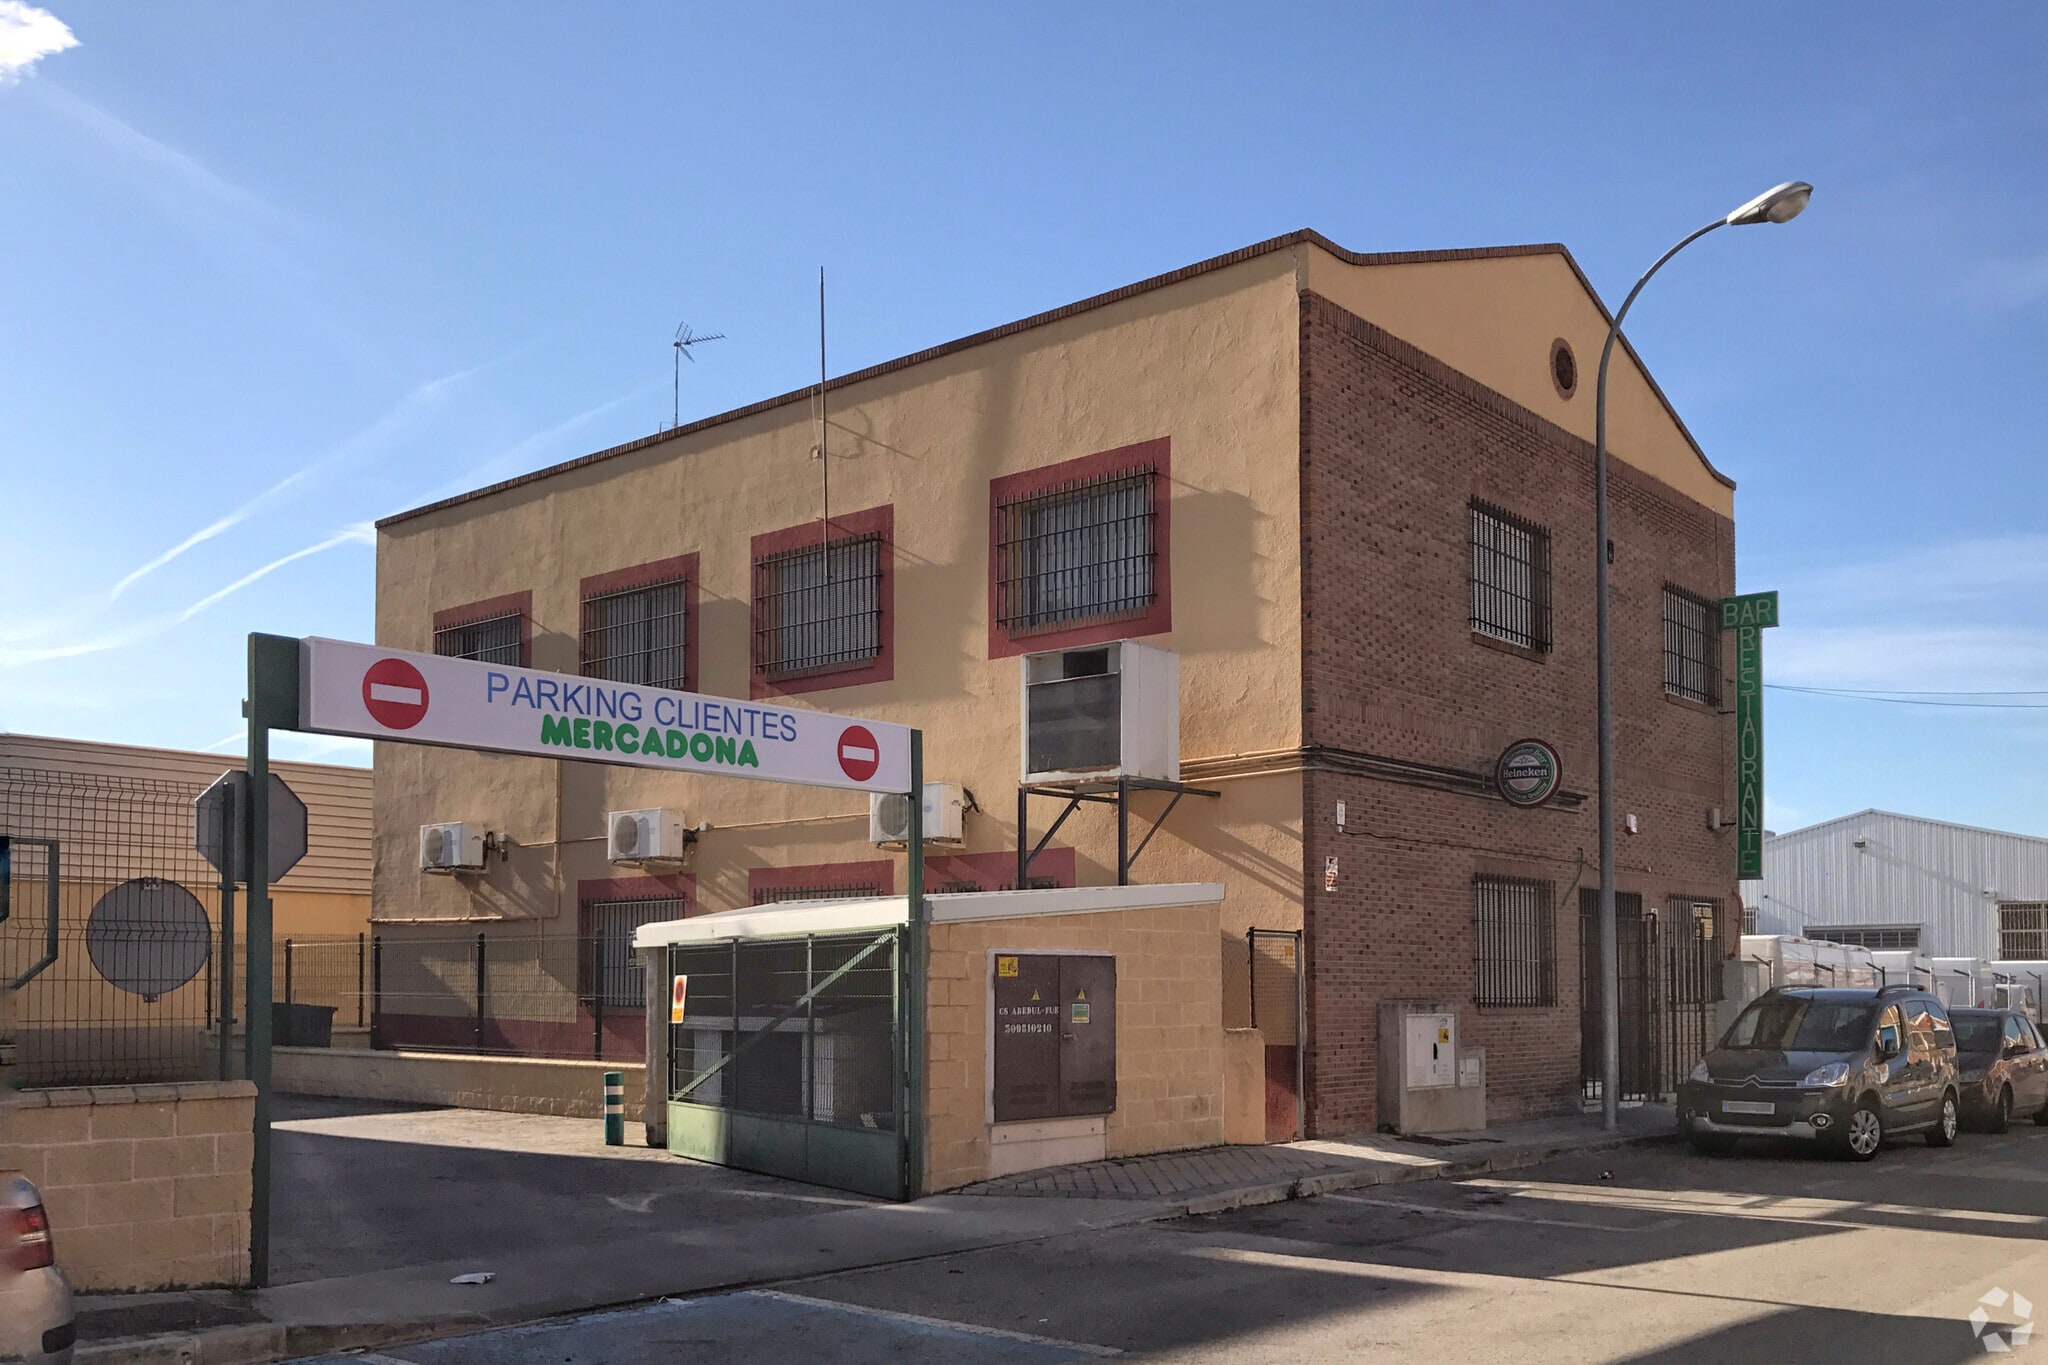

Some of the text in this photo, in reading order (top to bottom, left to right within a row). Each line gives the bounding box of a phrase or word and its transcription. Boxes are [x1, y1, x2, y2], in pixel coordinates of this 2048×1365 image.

[1722, 599, 1772, 627] BAR
[486, 671, 798, 743] PARKING CLIENTES
[540, 713, 760, 769] MERCADONA
[1740, 626, 1758, 873] RESTAURANTE
[1503, 767, 1547, 779] Heineken
[999, 1007, 1009, 1016] CS
